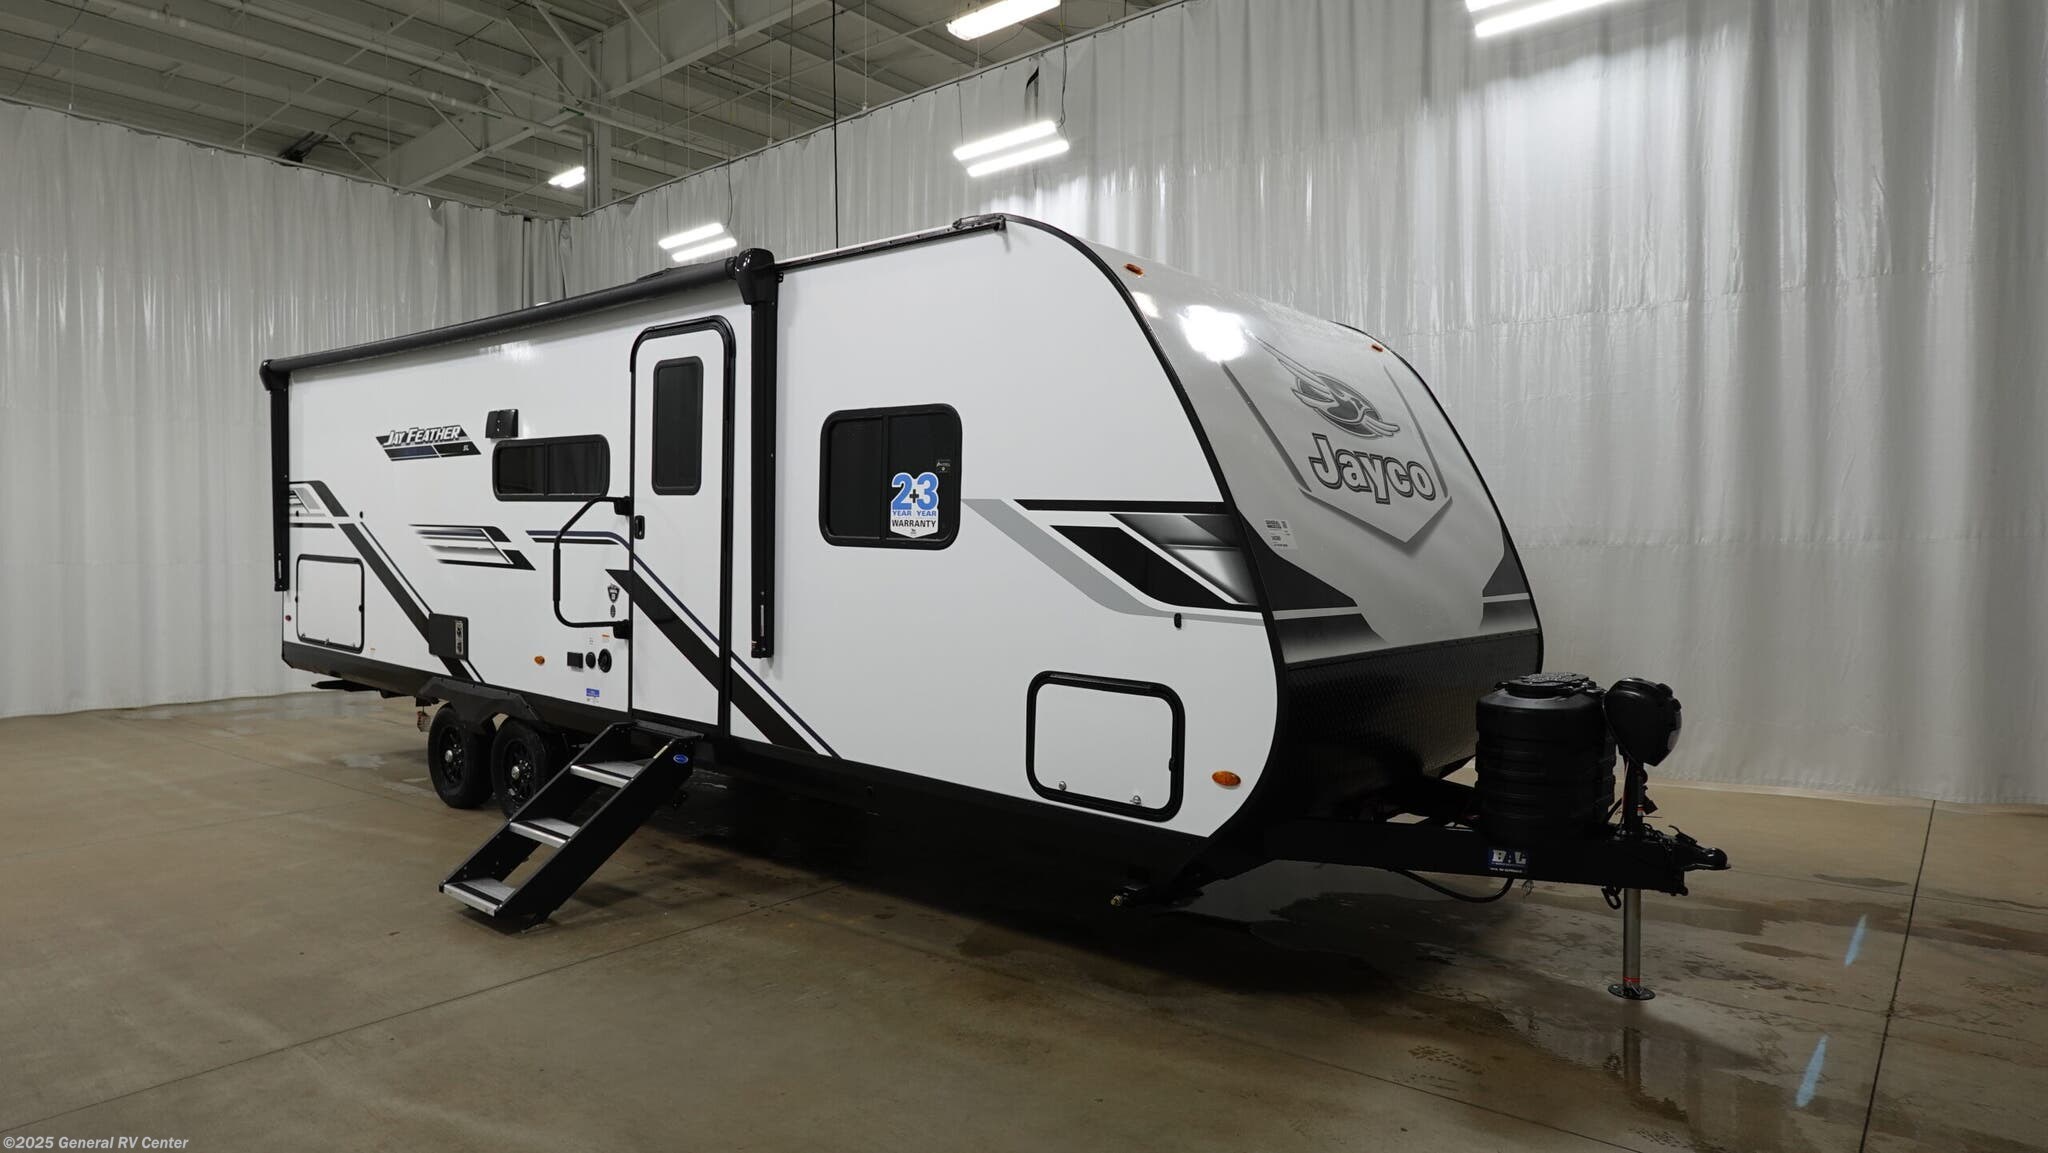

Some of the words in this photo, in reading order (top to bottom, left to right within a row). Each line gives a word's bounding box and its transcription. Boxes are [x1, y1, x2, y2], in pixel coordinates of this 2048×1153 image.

[383, 431, 406, 447] JAY
[407, 426, 461, 444] FEATHER
[1308, 433, 1436, 505] Jayco
[892, 519, 937, 528] WARRANTY
